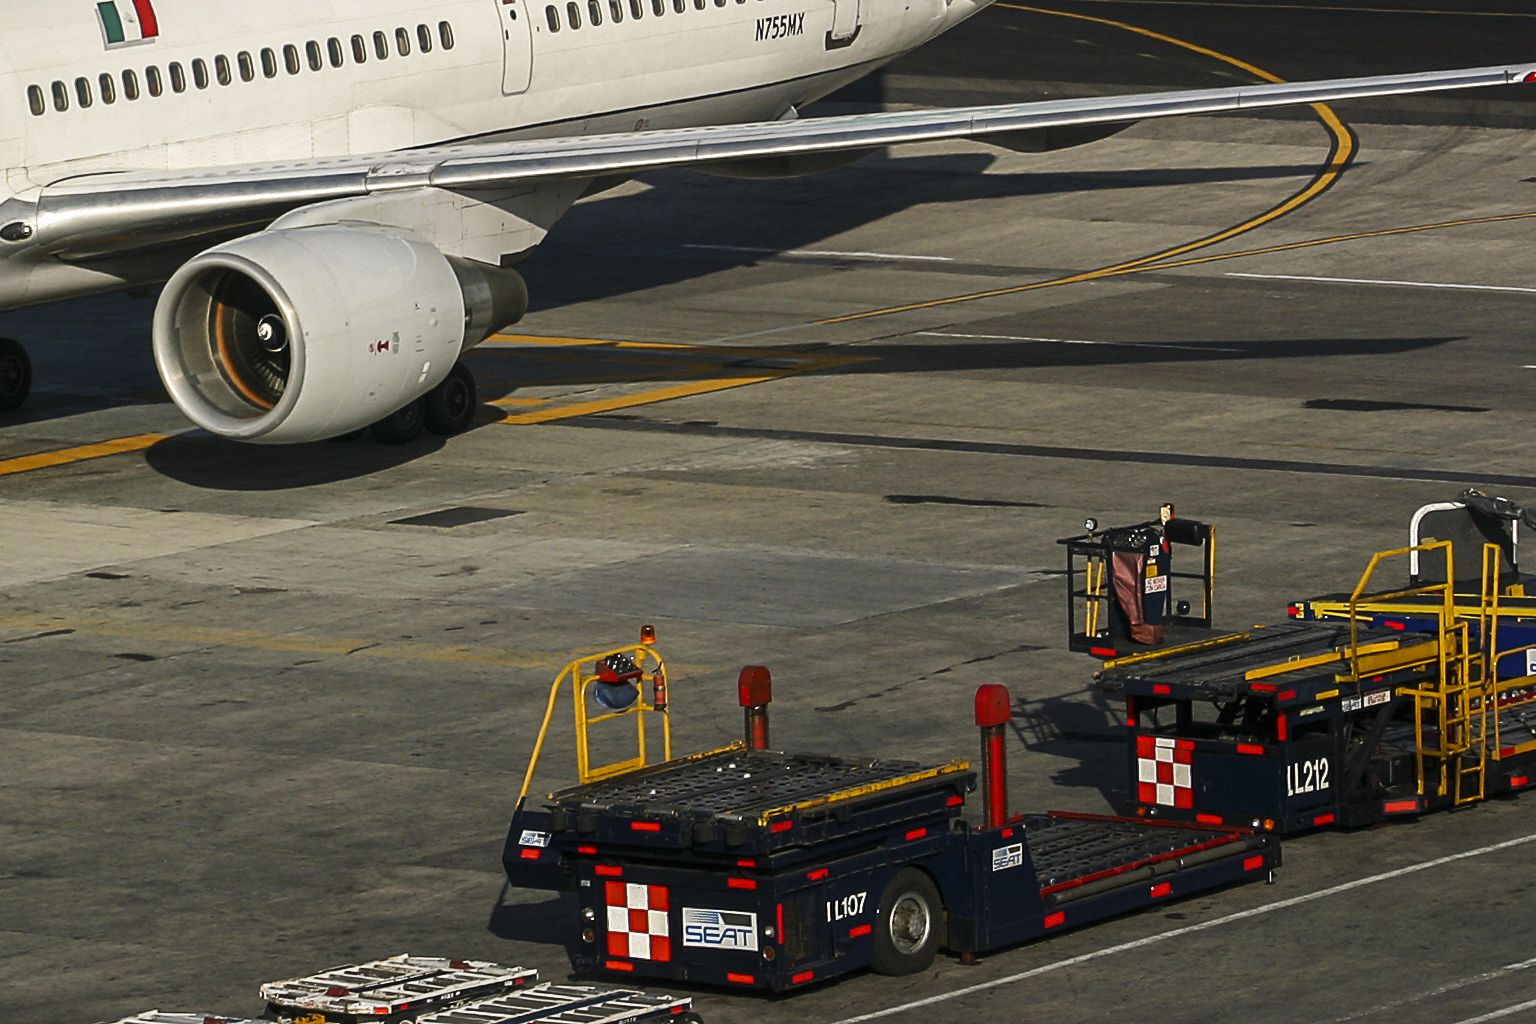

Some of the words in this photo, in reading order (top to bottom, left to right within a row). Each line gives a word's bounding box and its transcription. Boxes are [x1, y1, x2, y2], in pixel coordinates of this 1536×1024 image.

[755, 12, 805, 41] N755MX
[994, 853, 1022, 869] SEAT
[685, 925, 753, 947] SEAT
